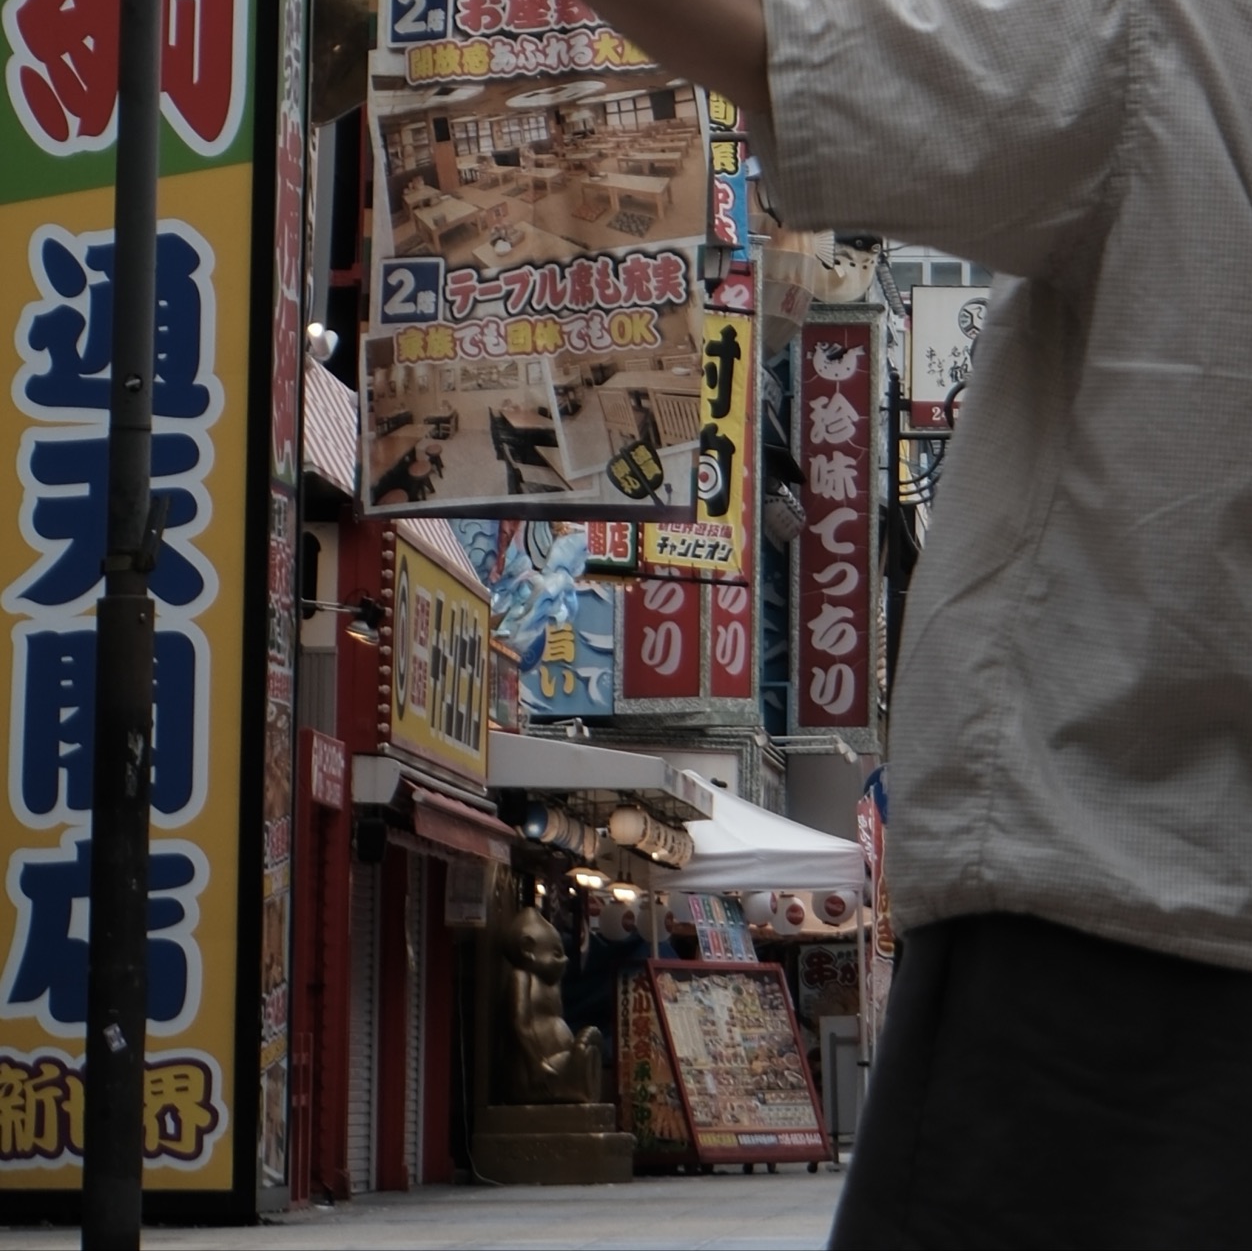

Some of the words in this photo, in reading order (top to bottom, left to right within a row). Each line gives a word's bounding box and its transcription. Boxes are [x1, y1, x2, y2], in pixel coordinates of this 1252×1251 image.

[448, 255, 684, 318] テーブル席も充実
[657, 536, 733, 562] チャンピオン
[807, 392, 866, 714] 珍味てっちり
